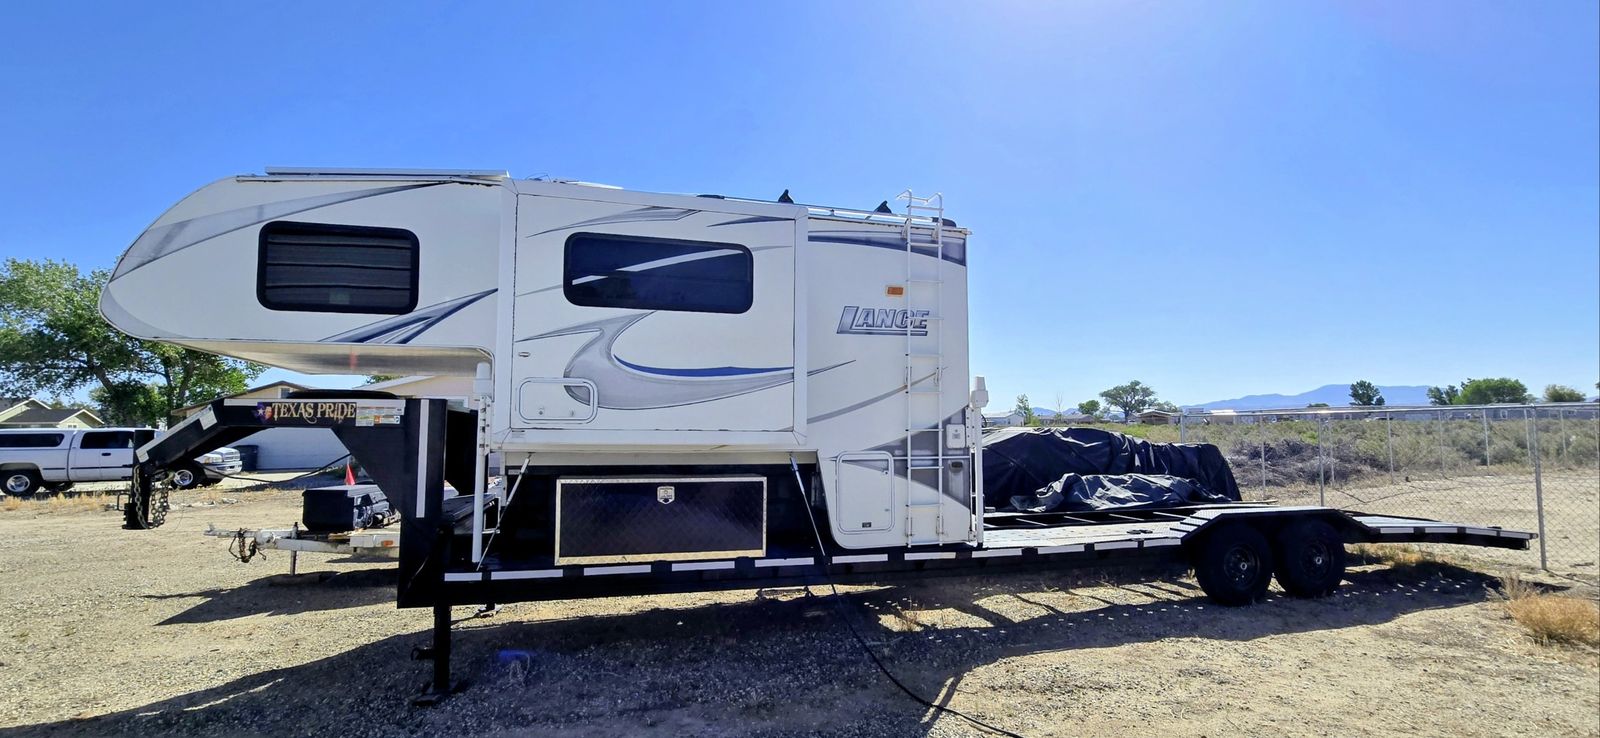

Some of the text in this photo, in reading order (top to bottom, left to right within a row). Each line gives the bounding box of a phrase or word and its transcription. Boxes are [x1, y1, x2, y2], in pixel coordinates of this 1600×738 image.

[836, 306, 930, 336] LANCE
[272, 402, 317, 422] TEXAS
[317, 402, 356, 421] PRIDE
